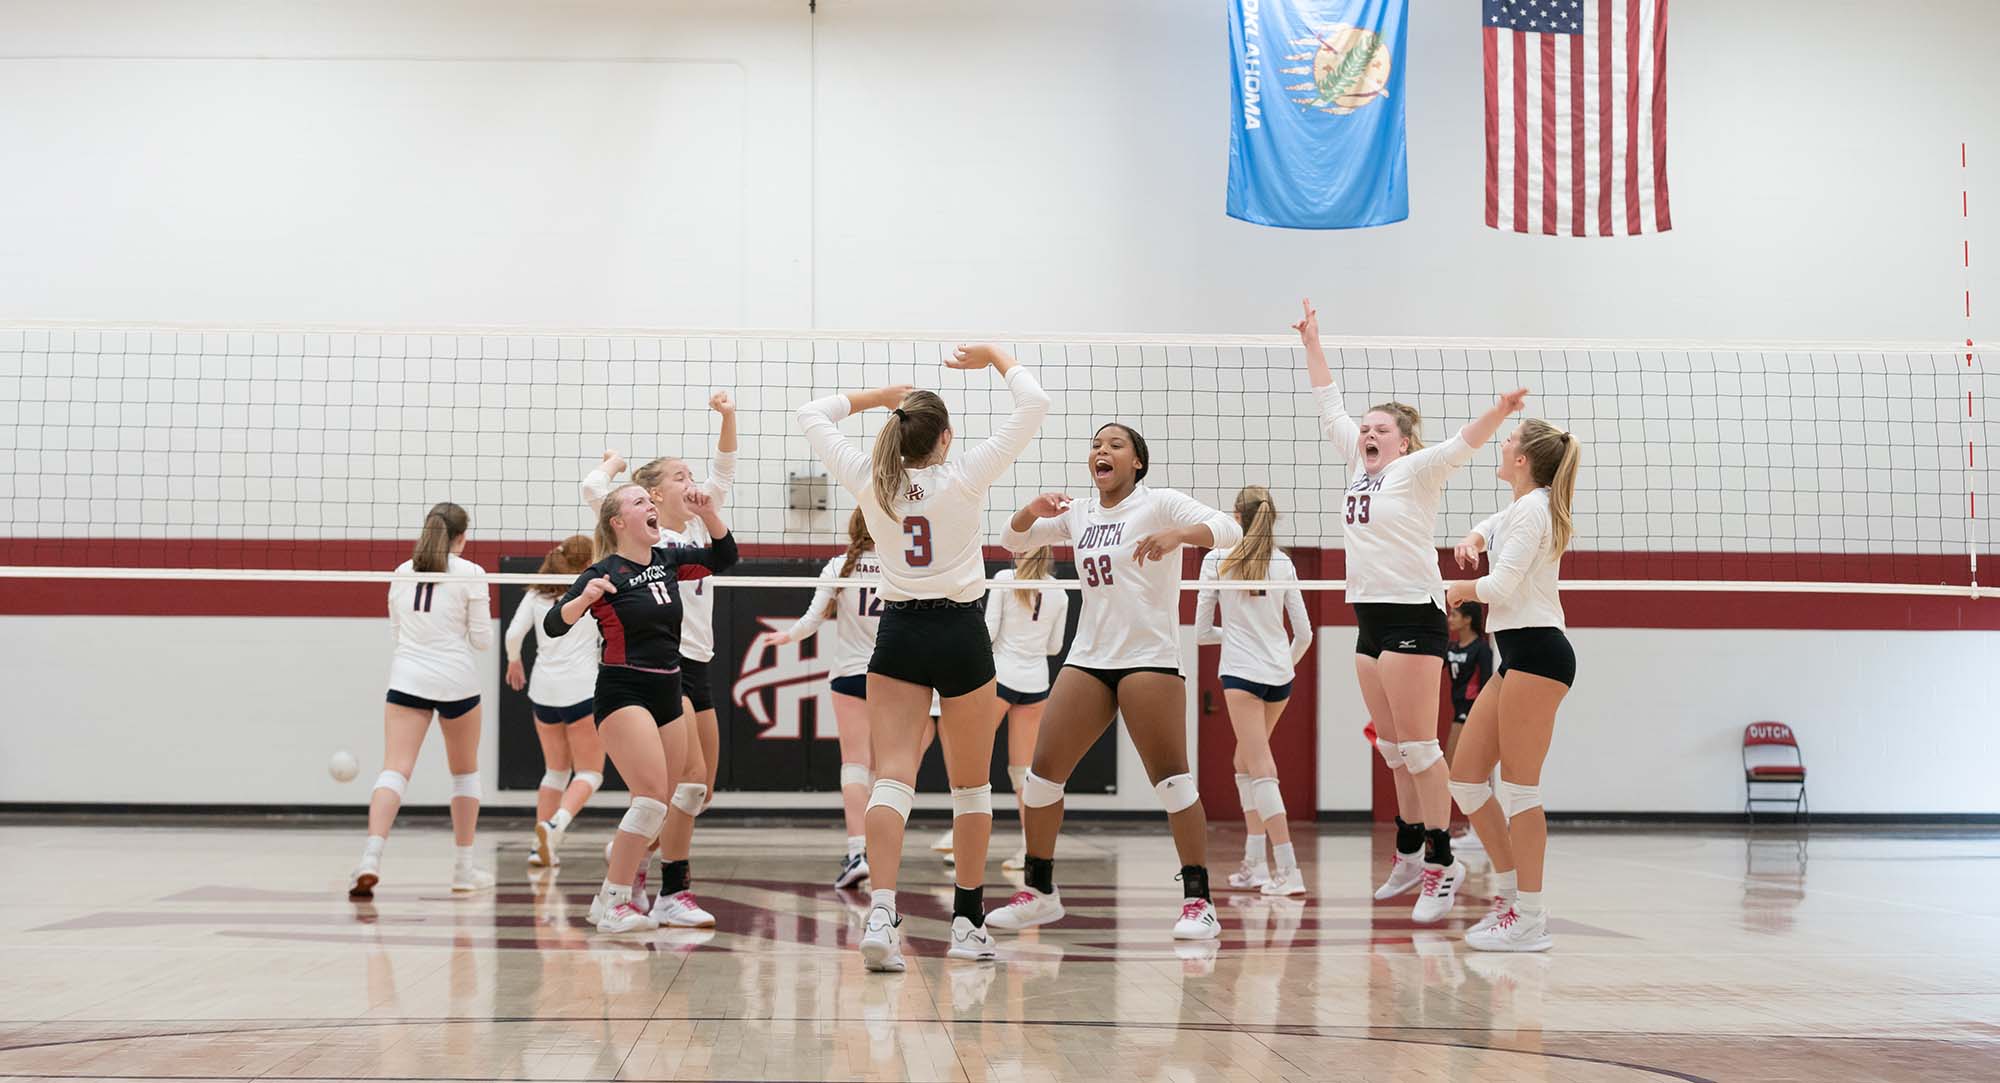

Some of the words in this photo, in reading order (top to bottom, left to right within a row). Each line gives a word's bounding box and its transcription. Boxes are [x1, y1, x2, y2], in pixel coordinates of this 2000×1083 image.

[1244, 0, 1261, 129] OKLAHOMA
[1346, 495, 1371, 525] 33
[903, 515, 933, 568] 3
[1078, 522, 1126, 549] DUTCH
[629, 564, 666, 587] DUTCH
[1083, 554, 1114, 587] 32
[413, 582, 434, 613] 11
[647, 581, 672, 605] 11
[858, 587, 883, 617] 12
[1750, 725, 1790, 739] DUTCH
